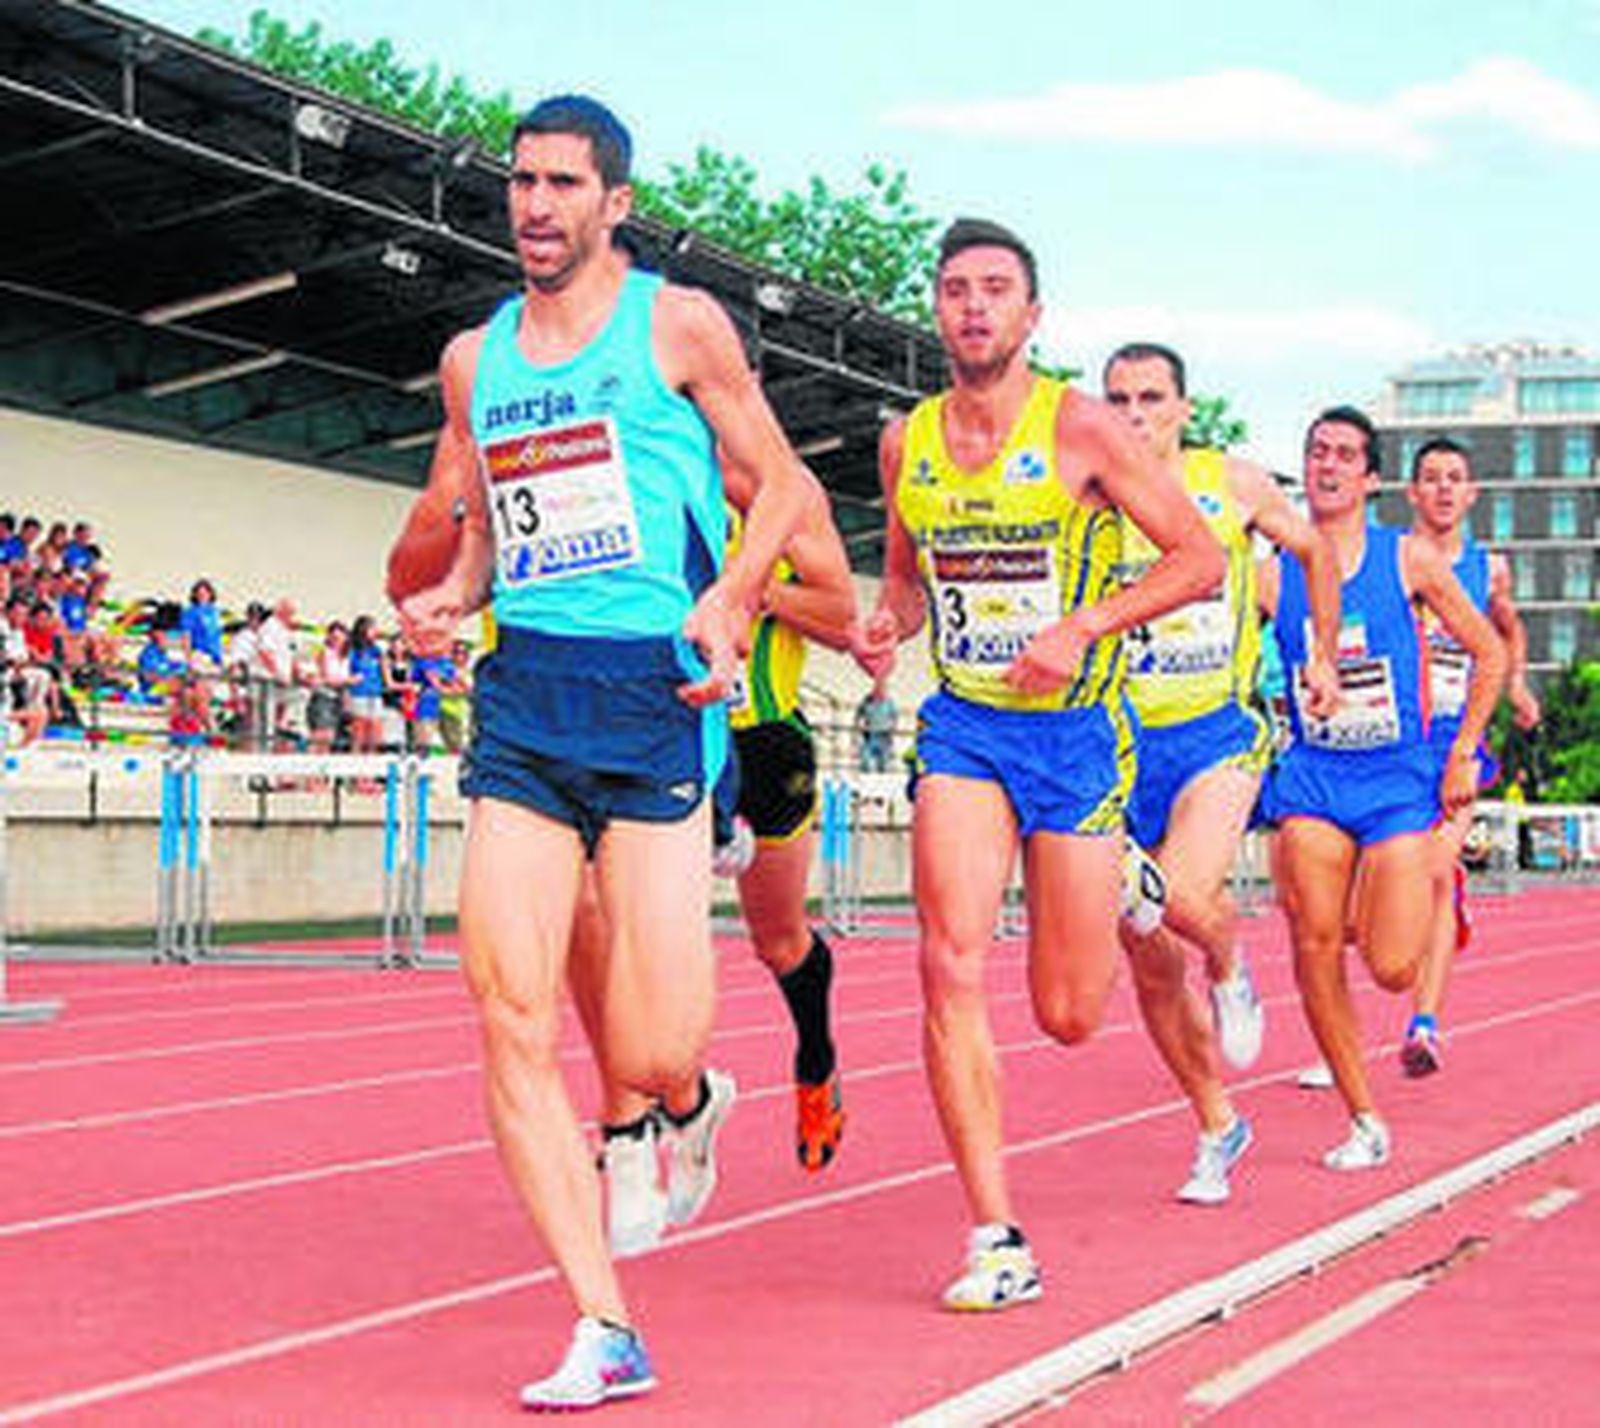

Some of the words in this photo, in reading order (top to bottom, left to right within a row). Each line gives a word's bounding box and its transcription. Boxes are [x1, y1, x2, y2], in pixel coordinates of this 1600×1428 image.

[485, 390, 576, 429] nerja
[496, 487, 540, 538] 13
[943, 587, 967, 630] 3
